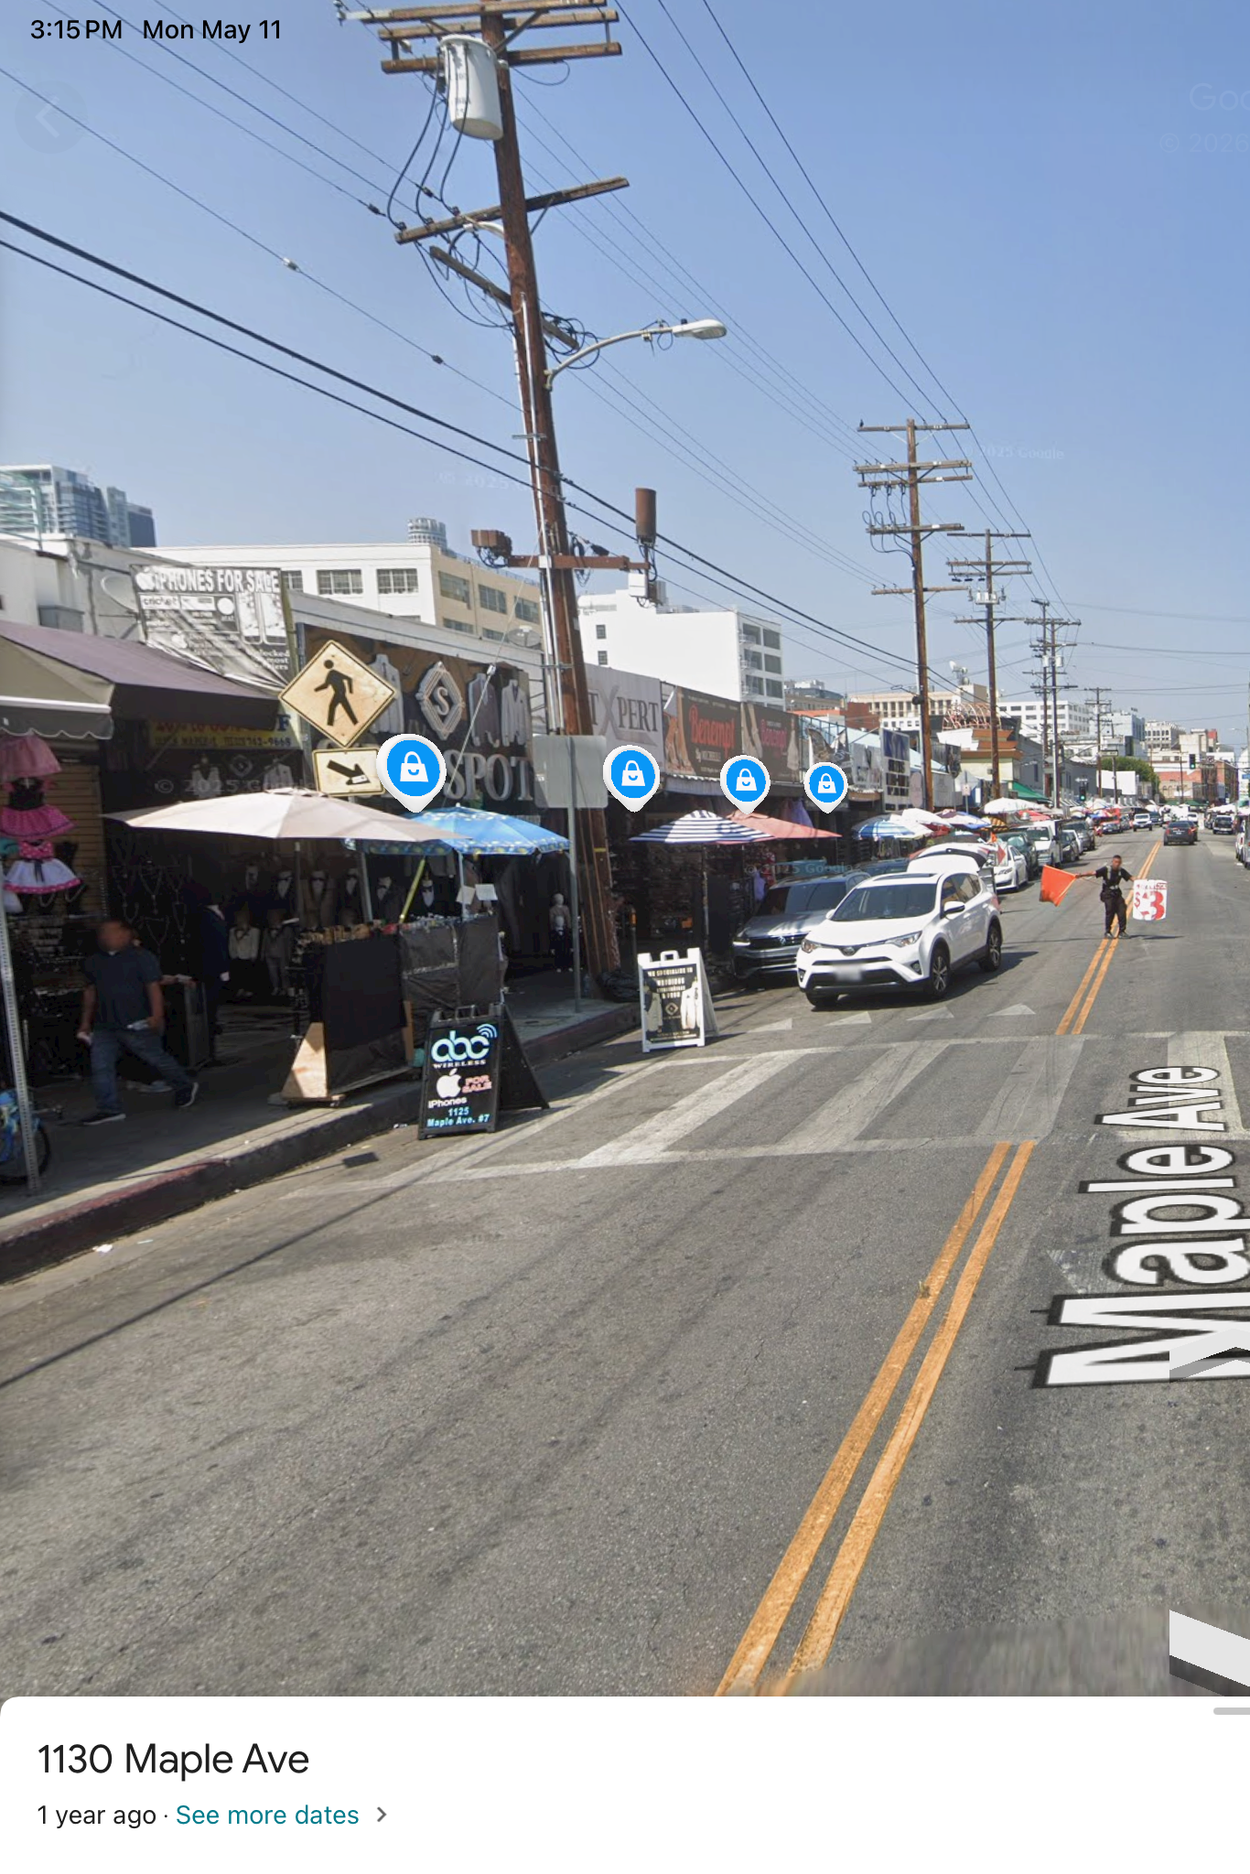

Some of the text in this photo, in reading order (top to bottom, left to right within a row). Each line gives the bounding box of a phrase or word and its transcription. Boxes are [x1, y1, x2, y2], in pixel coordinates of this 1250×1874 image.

[217, 569, 244, 593] FOR
[246, 569, 281, 594] SALE
[442, 749, 534, 802] SPOT
[431, 1030, 490, 1063] abc
[433, 1060, 486, 1069] WIRELESS
[427, 1097, 467, 1110] iPhones
[448, 1107, 470, 1117] 1125
[426, 1117, 453, 1128] Maple
[455, 1115, 476, 1126] Ave.
